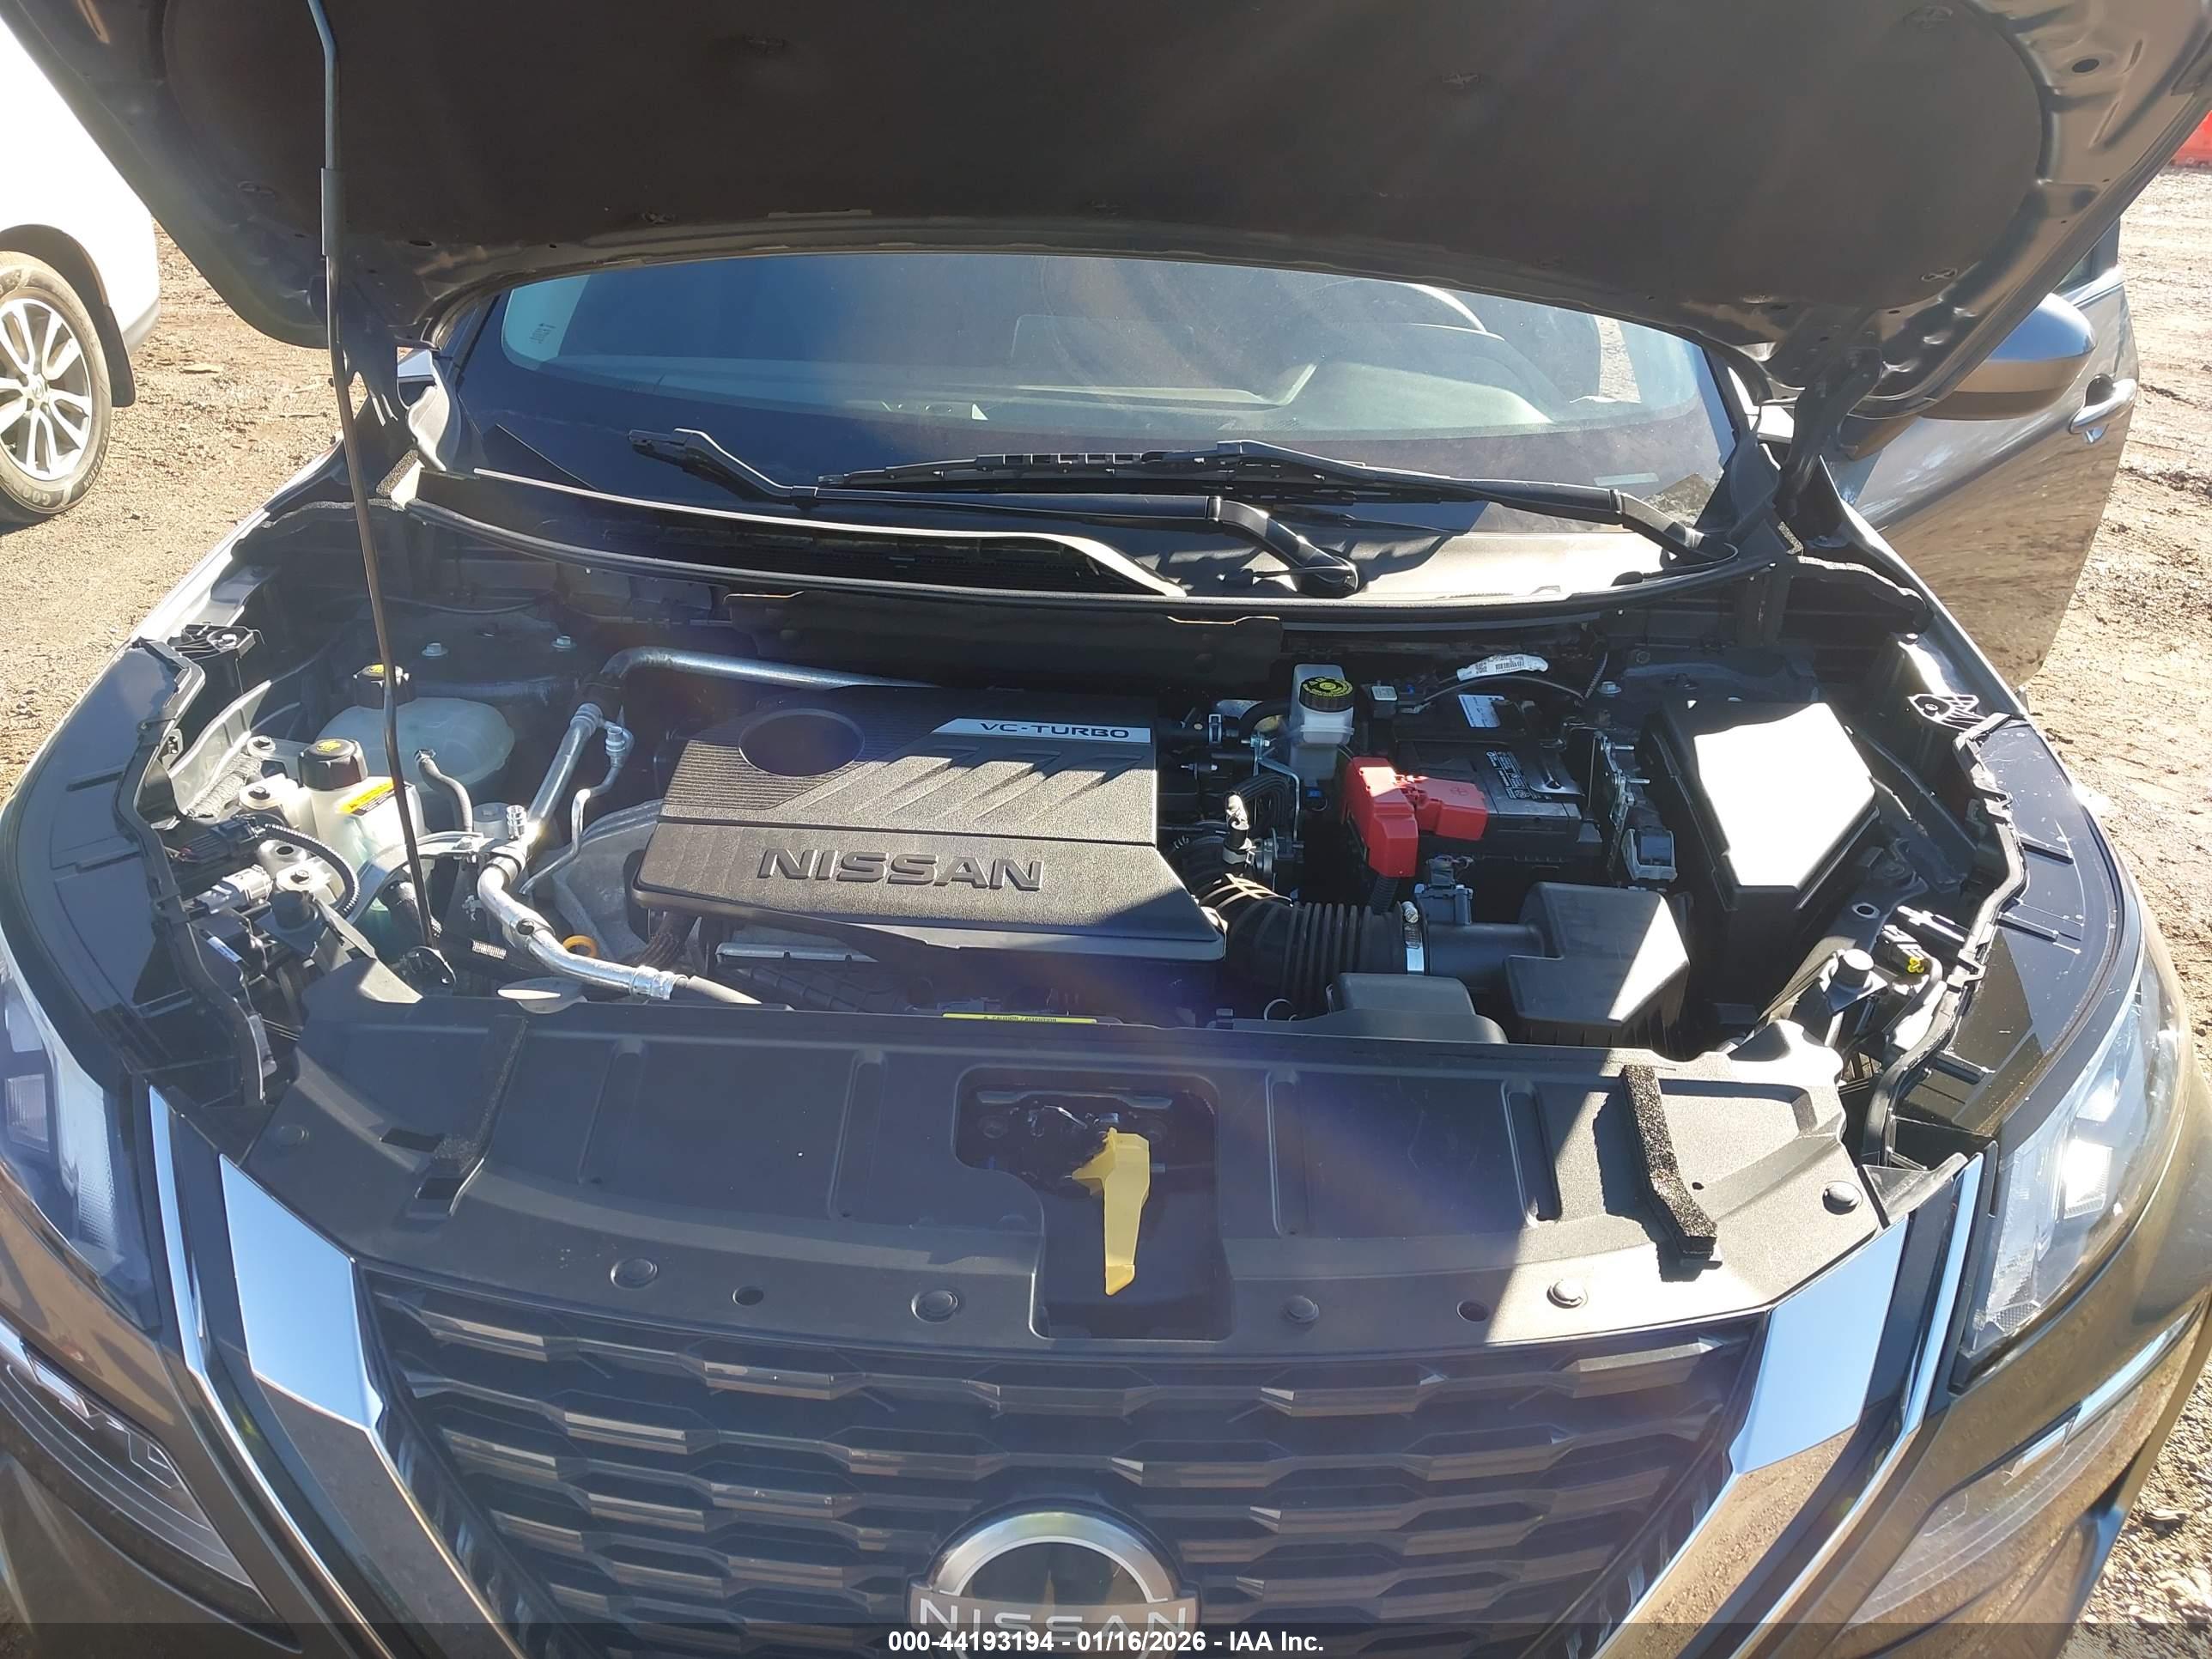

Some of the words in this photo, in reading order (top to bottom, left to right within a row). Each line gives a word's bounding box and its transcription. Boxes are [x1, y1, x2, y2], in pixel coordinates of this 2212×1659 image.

[980, 722, 1130, 738] VC-TURBO
[757, 848, 1044, 891] NISSAN
[919, 1598, 1186, 1641] NISSAN
